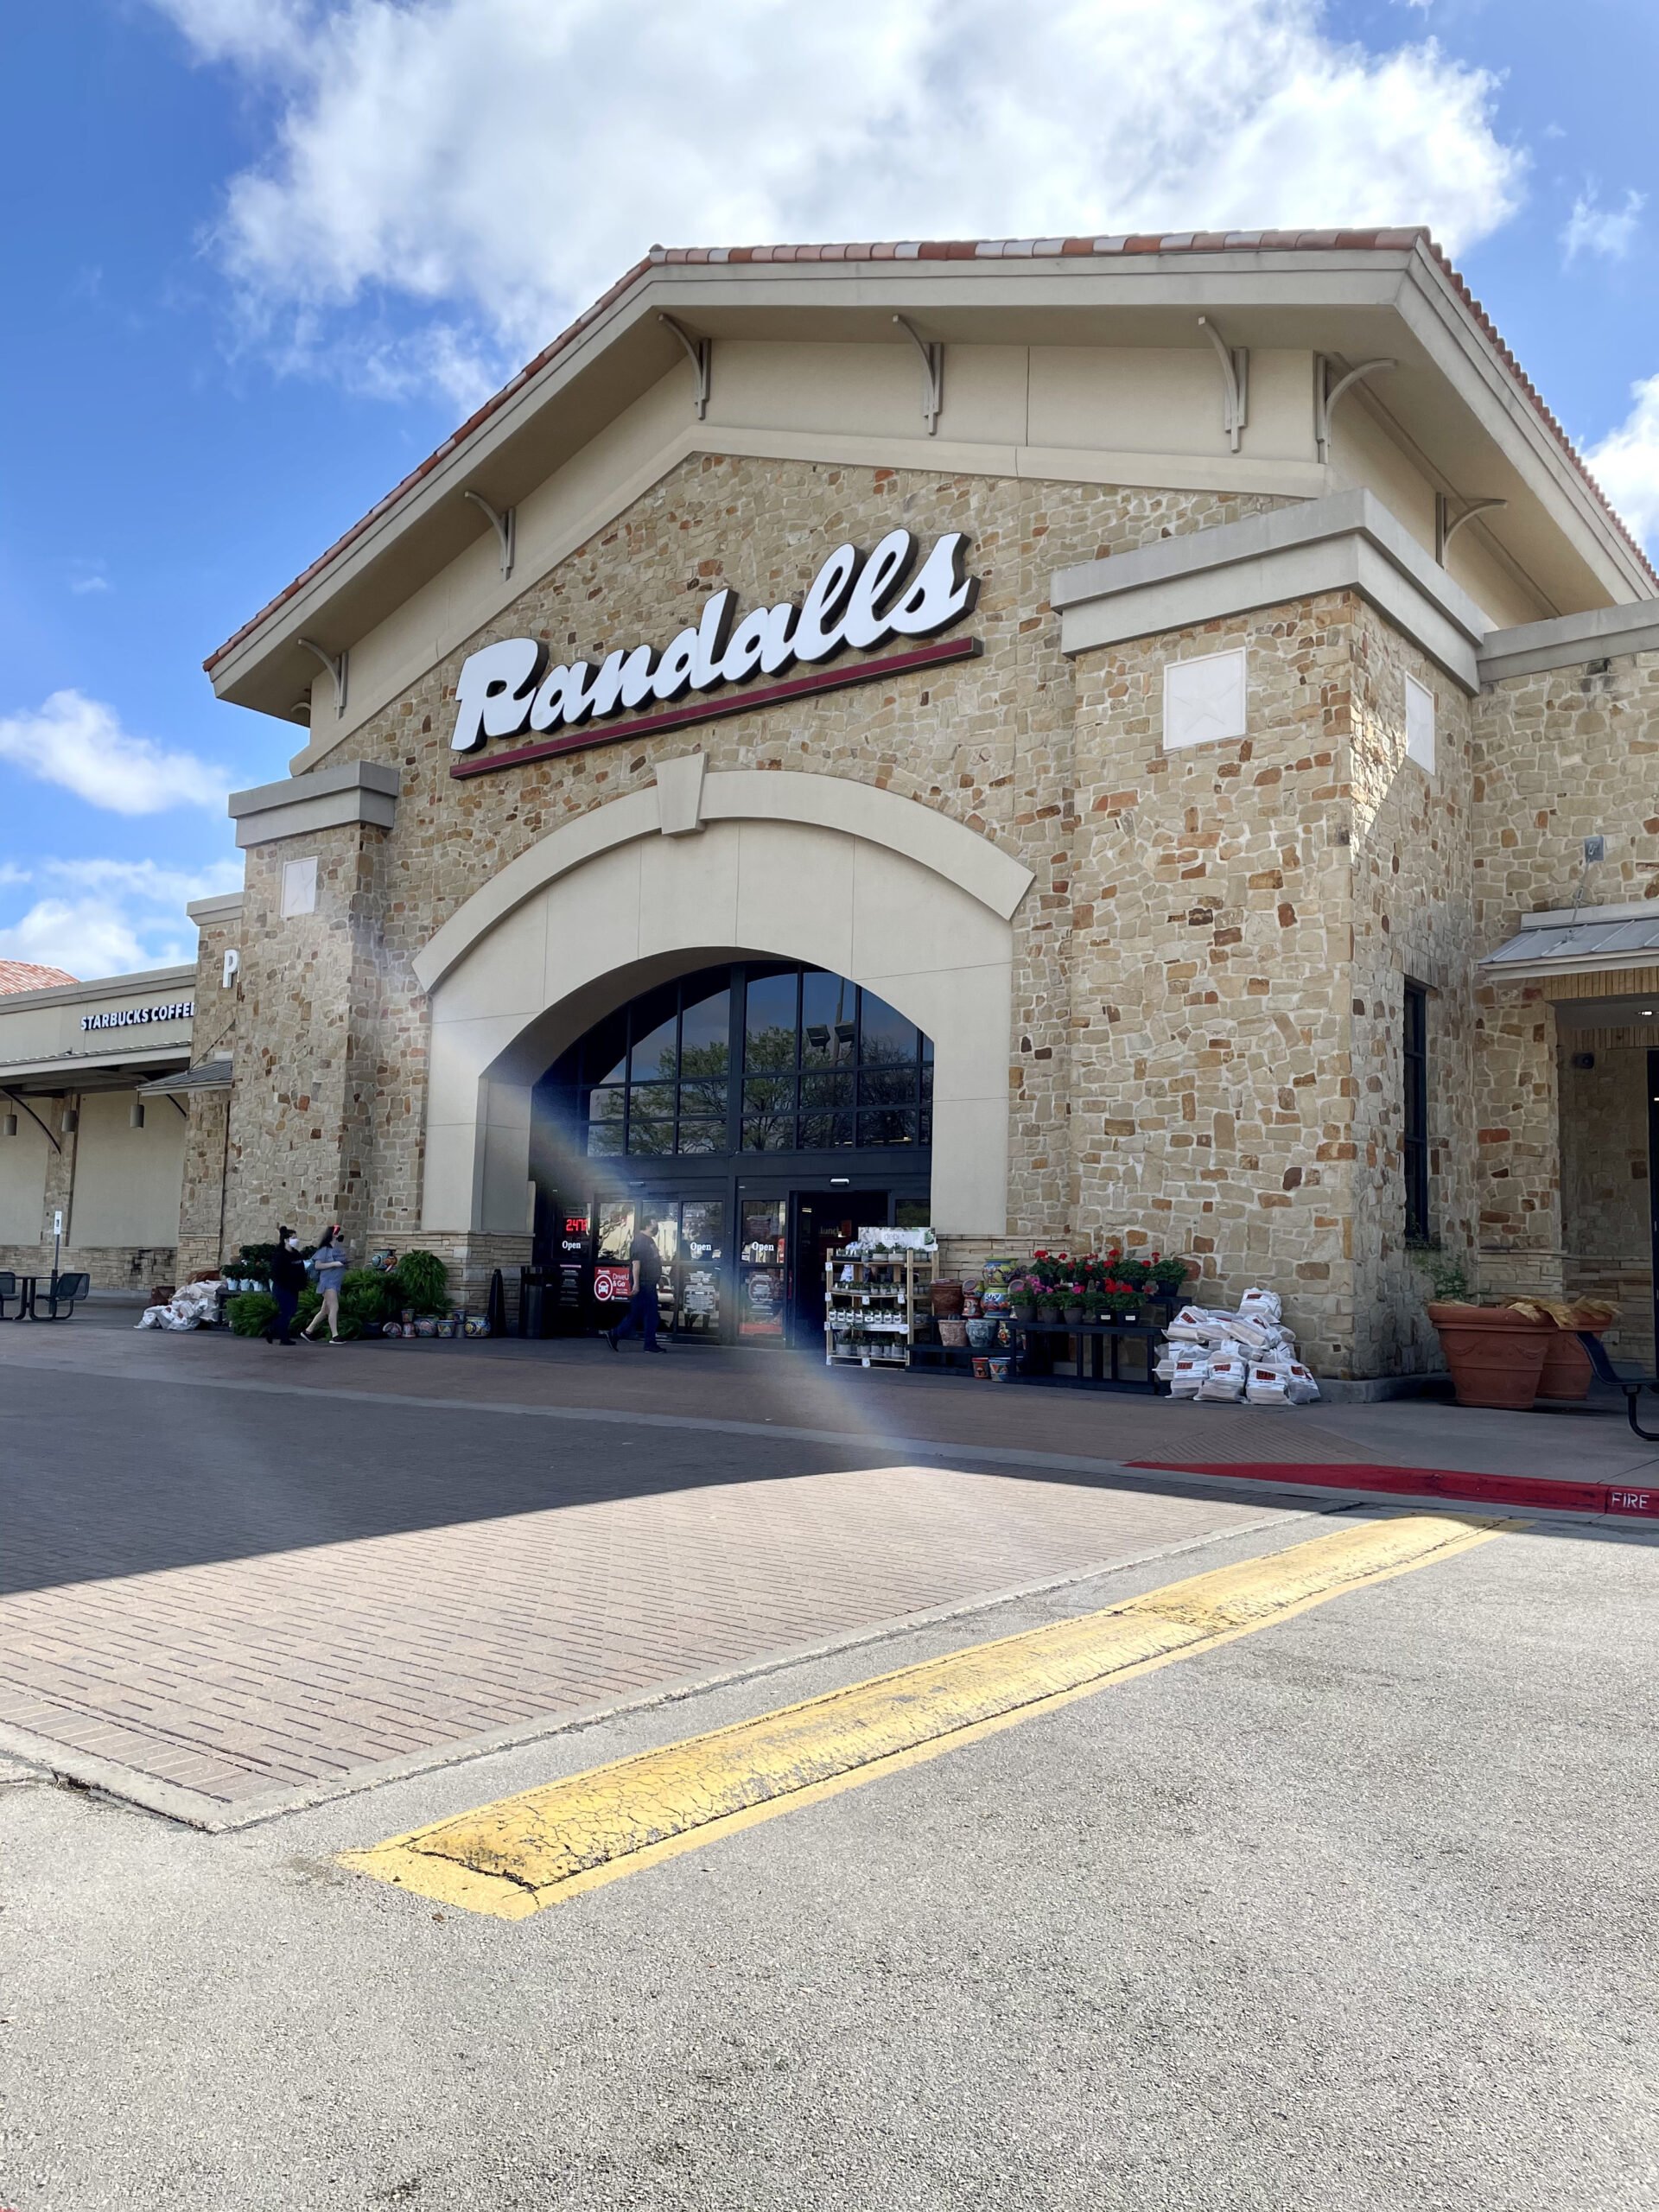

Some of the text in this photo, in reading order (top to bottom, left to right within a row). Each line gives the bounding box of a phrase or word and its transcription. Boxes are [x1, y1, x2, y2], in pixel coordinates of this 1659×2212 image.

[450, 528, 980, 753] Randalls
[80, 1008, 149, 1031] STARBUCKS
[562, 1241, 581, 1251] Open
[690, 1242, 712, 1251] Open
[752, 1242, 774, 1251] Open
[1611, 1492, 1650, 1510] FIRE
